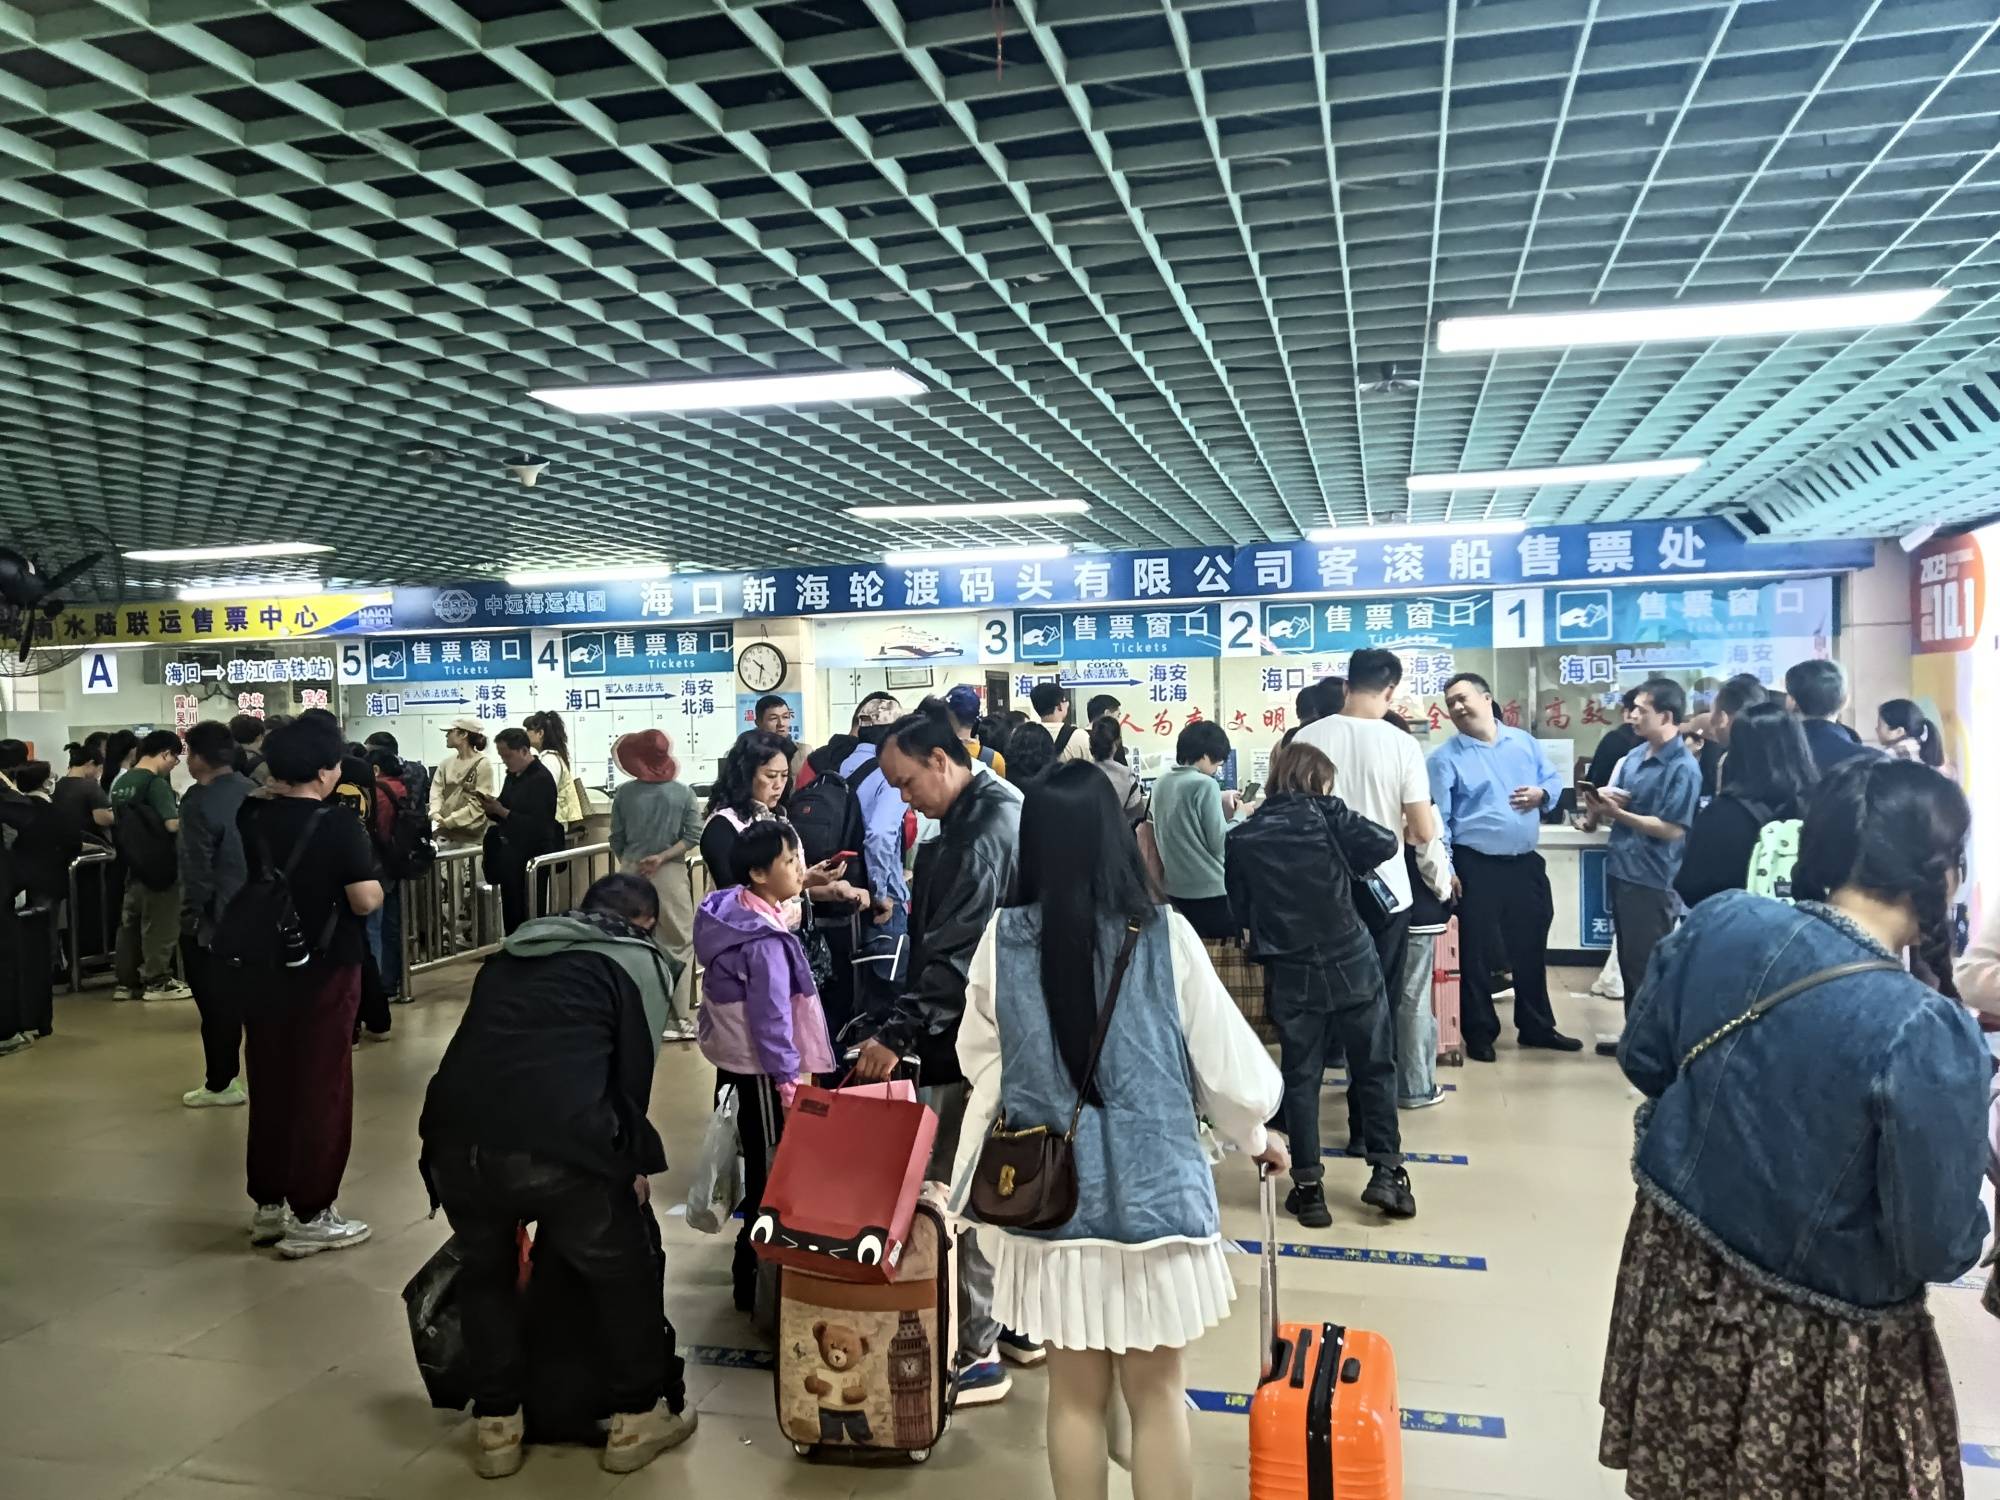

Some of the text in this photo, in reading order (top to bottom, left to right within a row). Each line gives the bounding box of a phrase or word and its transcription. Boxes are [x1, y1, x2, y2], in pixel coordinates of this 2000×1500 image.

[640, 526, 1705, 616] 海口新海轮渡码头有限公司客滚船售票处
[485, 590, 607, 616] 中远海运集团
[1637, 588, 1803, 619] 售票窗口
[1, 605, 318, 640] 南水陆联运售票中心
[1073, 612, 1208, 640] 售票窗口
[1228, 610, 1254, 649] 2
[1324, 601, 1476, 632] 售票窗口
[1507, 598, 1527, 638] 1
[614, 631, 729, 658] 售票窗口
[985, 620, 1008, 655] 3
[1113, 643, 1168, 653] Tickets
[343, 645, 361, 676] 5
[412, 639, 521, 664] 售票窗口
[537, 639, 559, 671] 4
[649, 659, 696, 669] Tickets
[1410, 655, 1452, 674] 海安
[88, 654, 113, 688] A
[167, 658, 332, 684] 海口 湛江(高铁站)
[444, 665, 489, 675] Tickets
[1087, 661, 1124, 669] COSCO
[1150, 664, 1187, 682] 海安
[1559, 655, 1614, 683] 海口
[475, 685, 506, 700] 海安
[681, 679, 714, 696] 海安
[1150, 684, 1188, 702] 北海
[1262, 668, 1304, 692] 海口
[367, 694, 400, 715] 海口
[565, 682, 665, 710] 海口 军人依法优先
[681, 698, 714, 715] 北海
[475, 703, 507, 719] 北海
